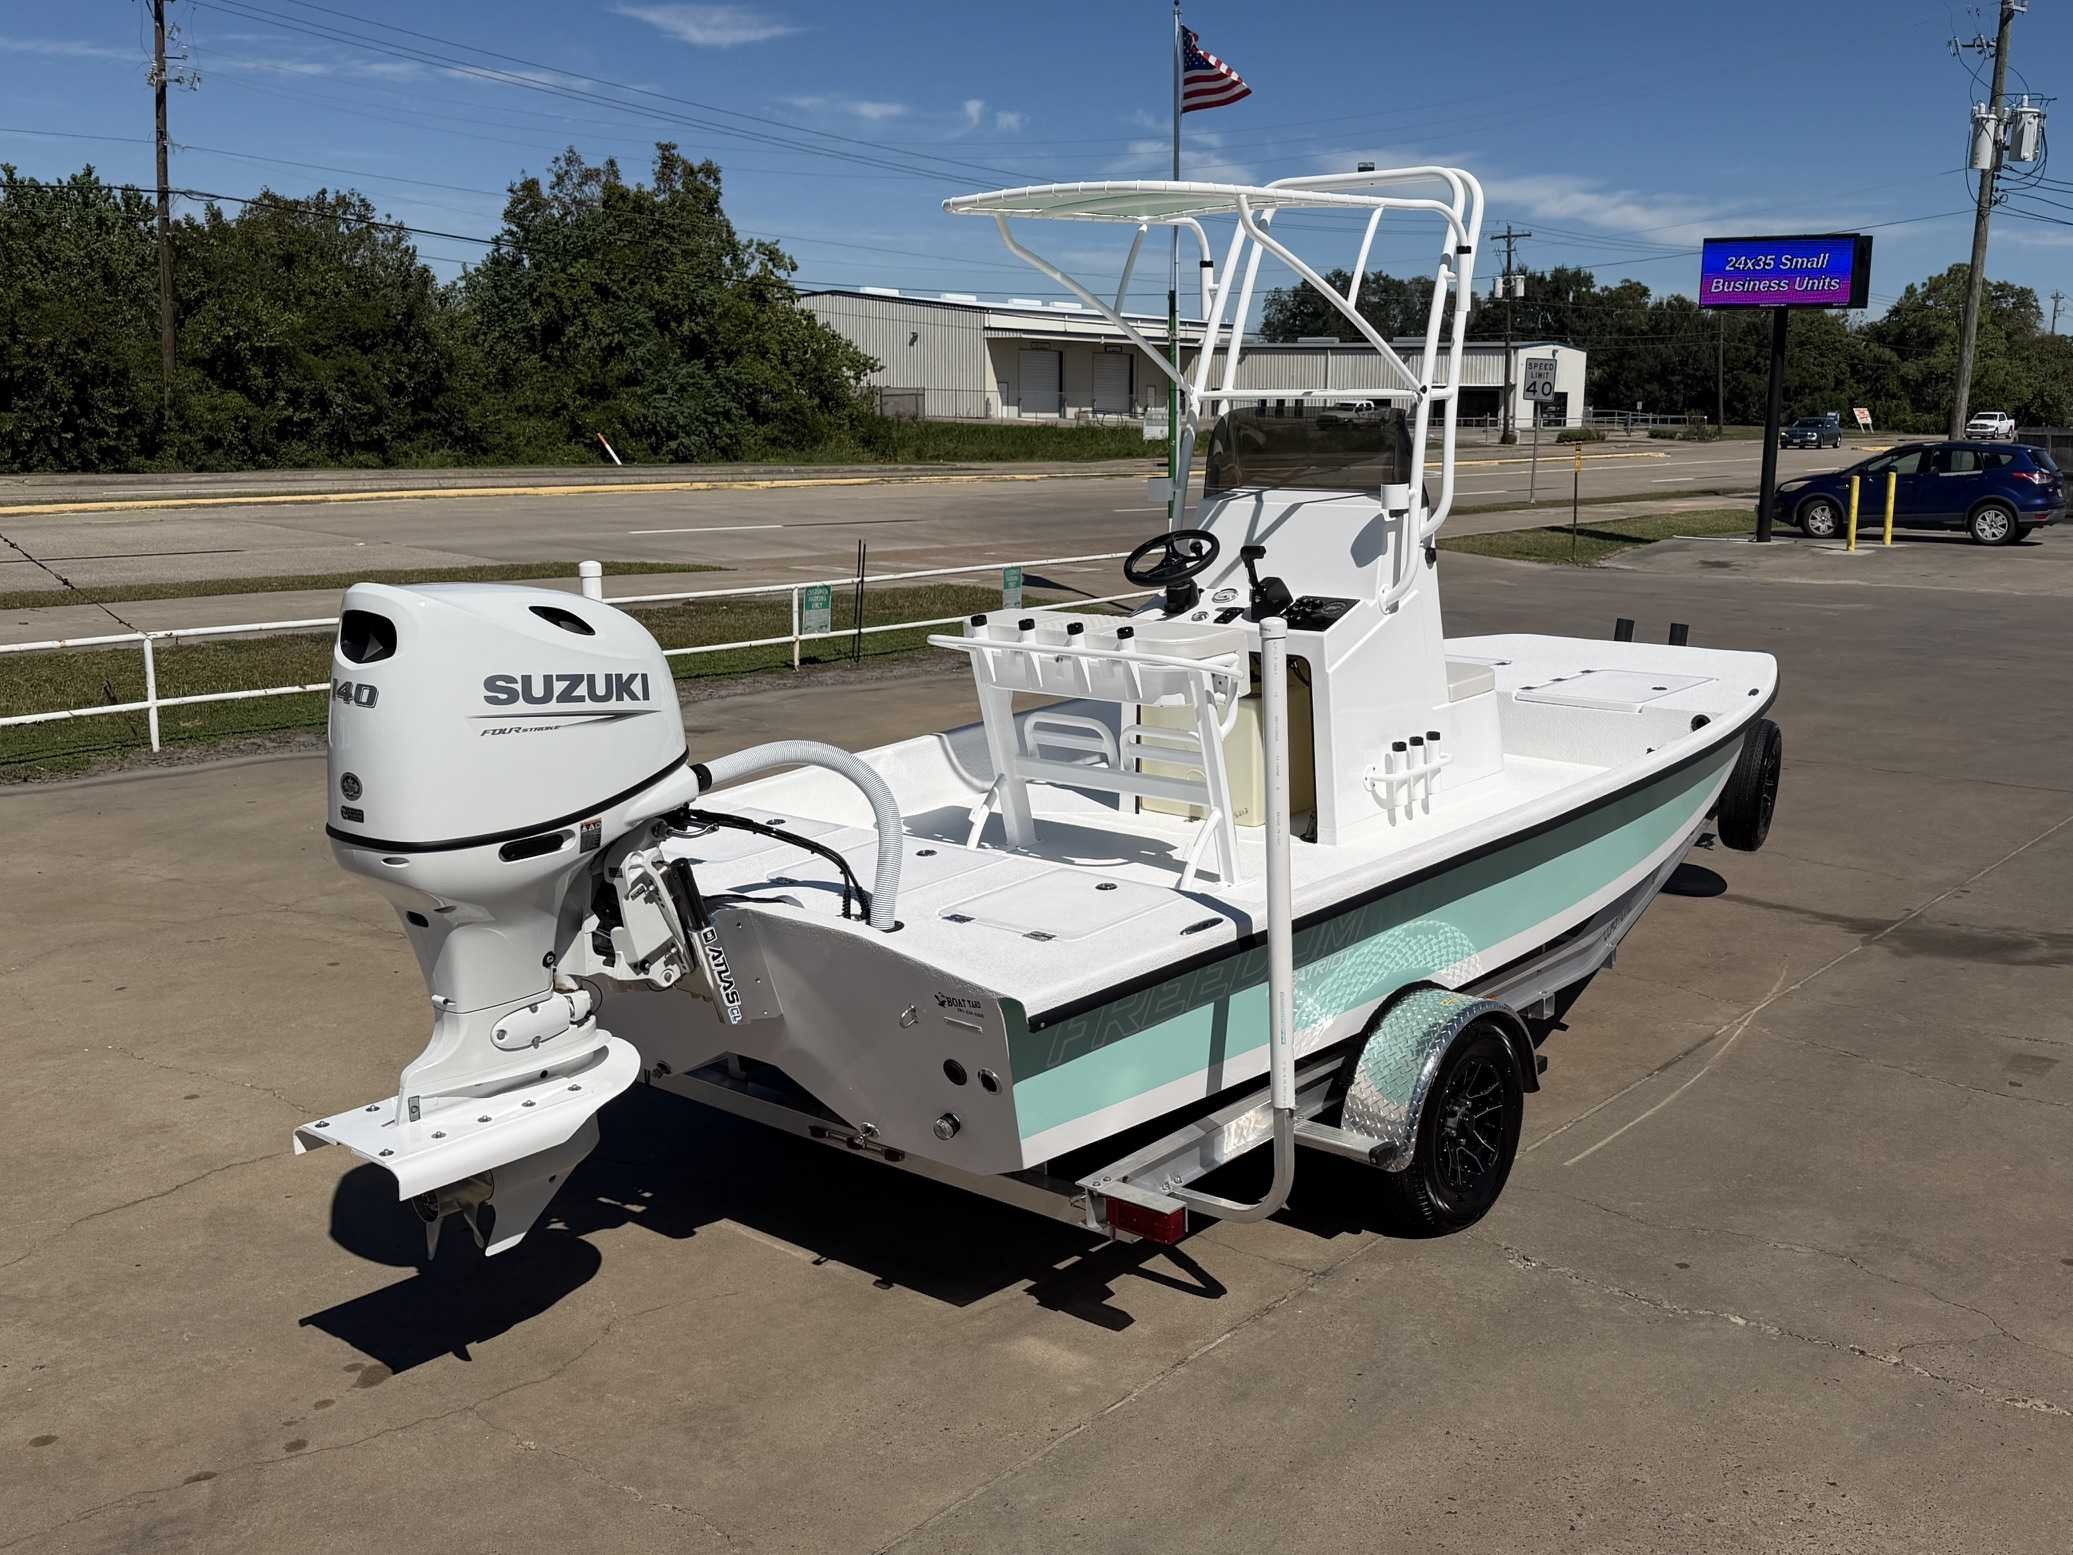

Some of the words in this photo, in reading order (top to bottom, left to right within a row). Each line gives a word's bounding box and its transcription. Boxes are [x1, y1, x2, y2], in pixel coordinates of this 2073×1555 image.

[1725, 255, 1775, 270] 24x35
[1780, 253, 1829, 269] Small
[1711, 278, 1789, 292] Business
[1795, 275, 1840, 290] Units
[1527, 362, 1553, 371] SPEED
[1530, 371, 1549, 379] LIMIT
[1526, 381, 1552, 396] 40
[483, 673, 650, 706] SUZUKI
[480, 727, 522, 736] FOUR
[706, 945, 741, 1006] ATLAS
[945, 996, 967, 1008] BOAT
